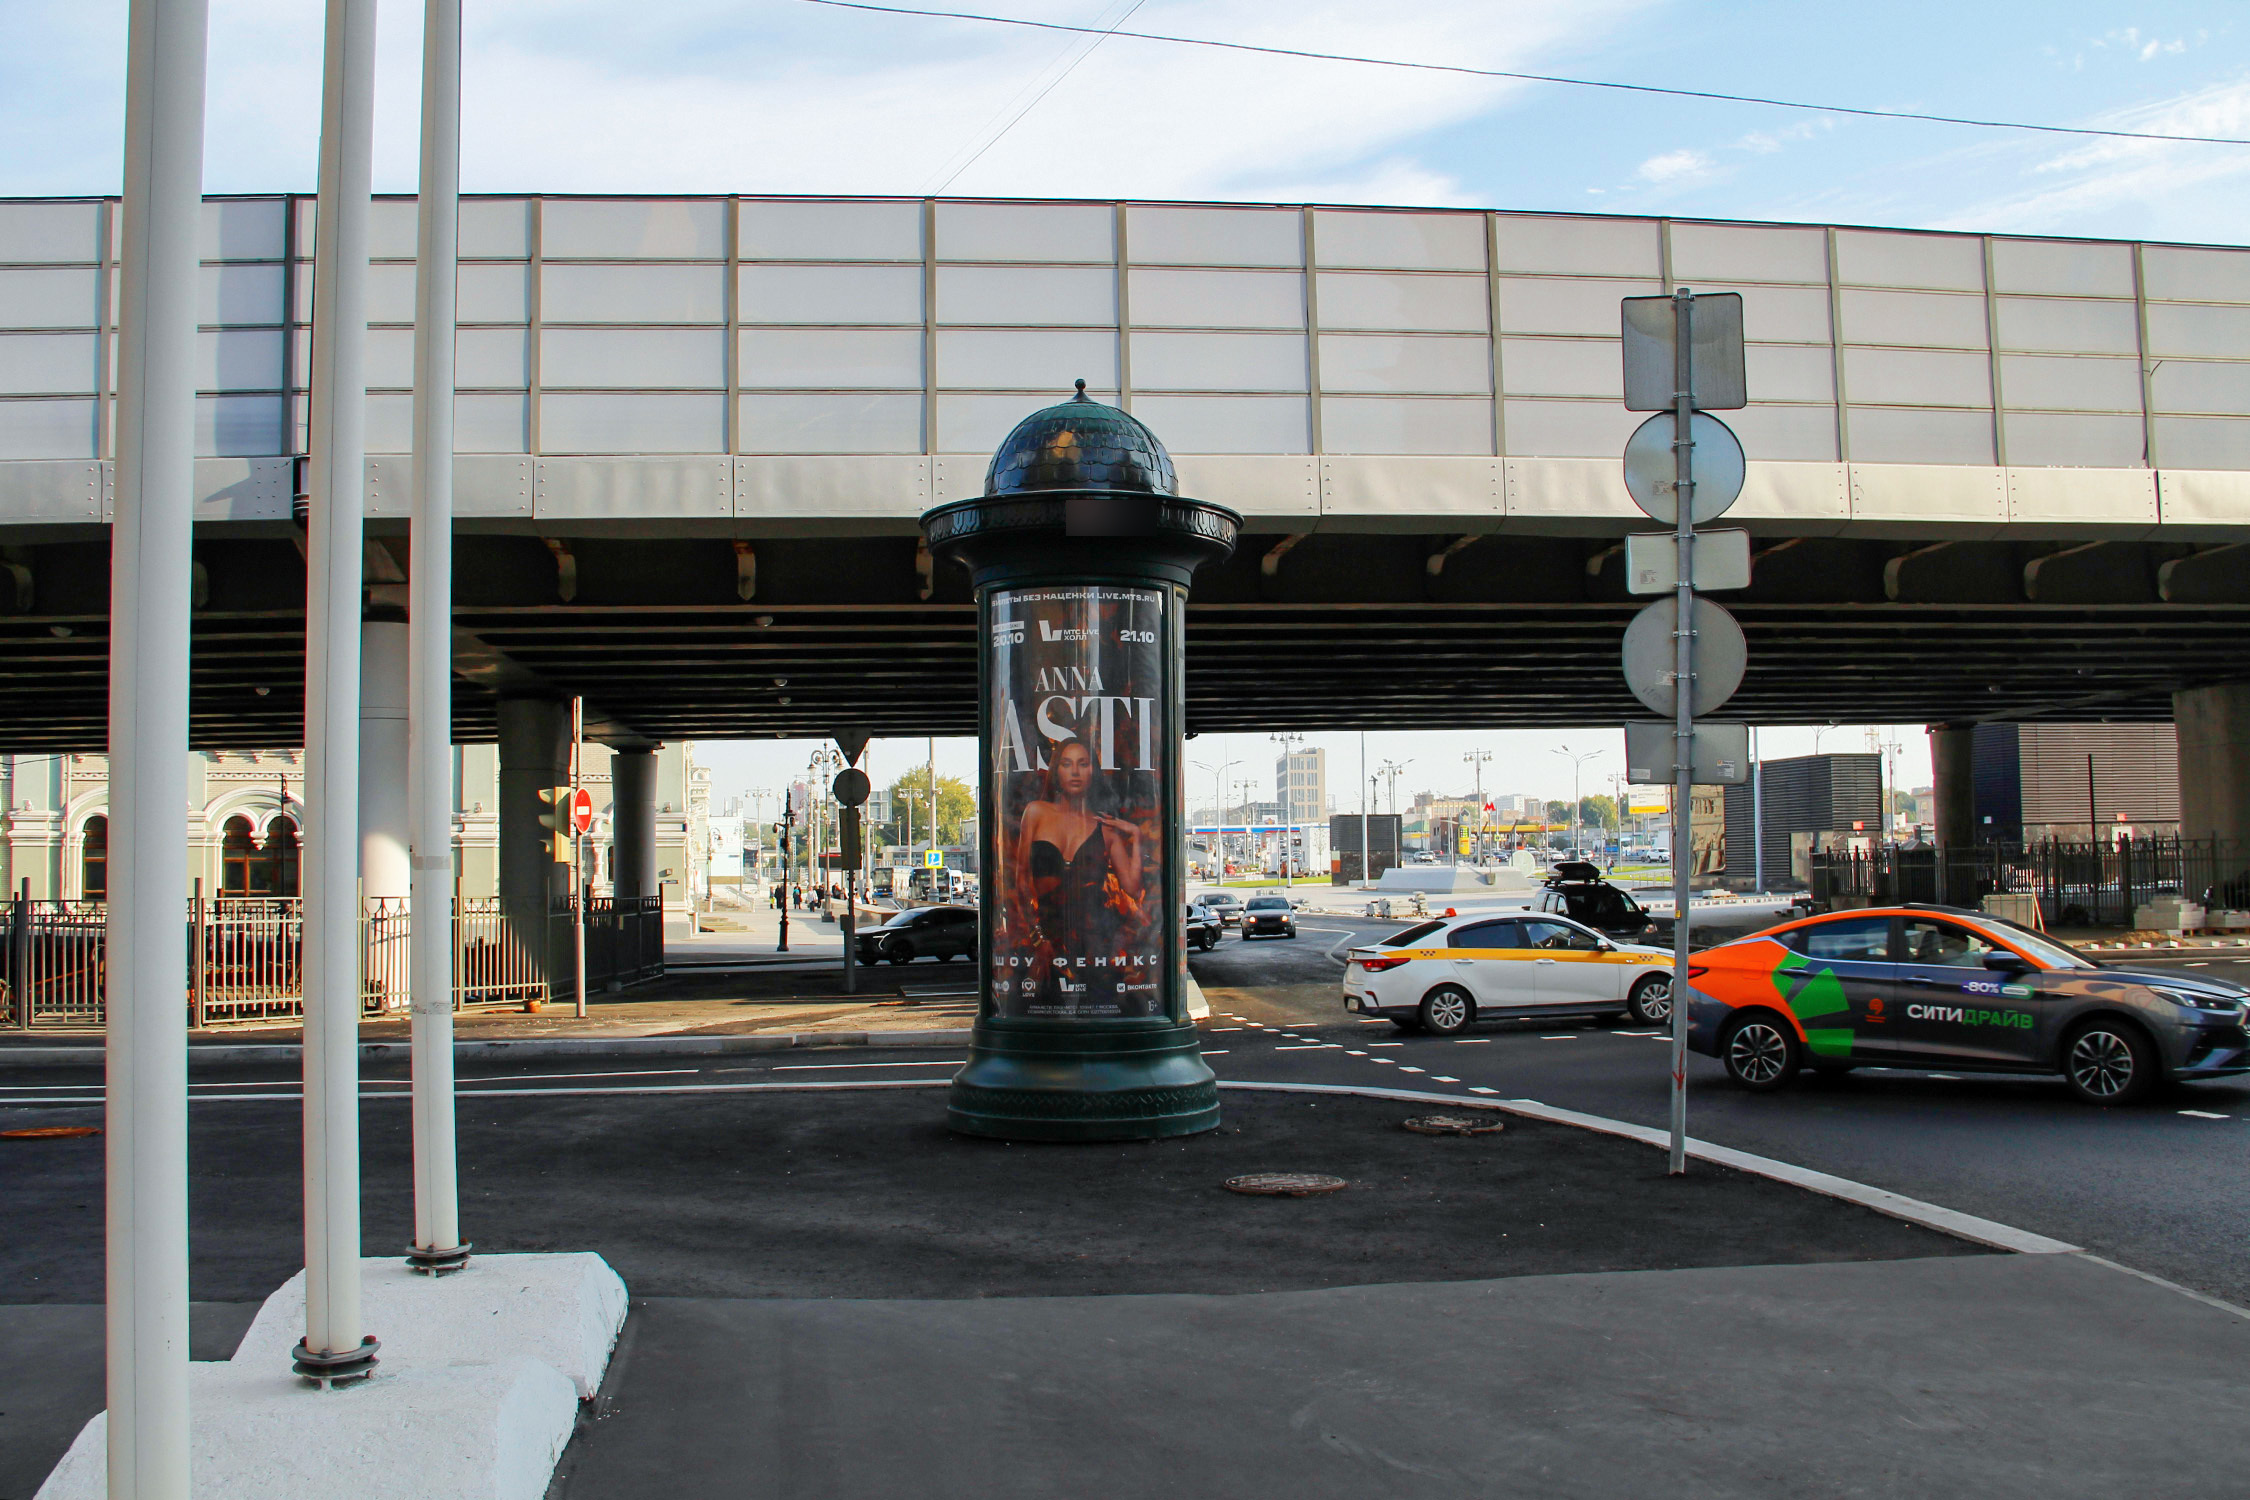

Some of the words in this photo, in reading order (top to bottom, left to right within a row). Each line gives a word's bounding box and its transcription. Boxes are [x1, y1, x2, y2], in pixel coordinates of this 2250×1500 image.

[1023, 594, 1041, 602] БЕЗ
[1043, 592, 1095, 601] НАЦЕНКИ
[1097, 592, 1155, 602] LIVE.MTS.RU
[993, 632, 1025, 648] 20.10
[1120, 629, 1155, 644] 21.10
[1034, 666, 1104, 692] ANNA
[993, 695, 1156, 773] ASTI
[995, 955, 1034, 967] ШОУ
[1052, 955, 1157, 968] ФЕНИКС
[1962, 981, 1999, 994] -80%
[1147, 999, 1158, 1012] 16+
[1907, 1004, 2033, 1029] СИТИДРАЙВ
